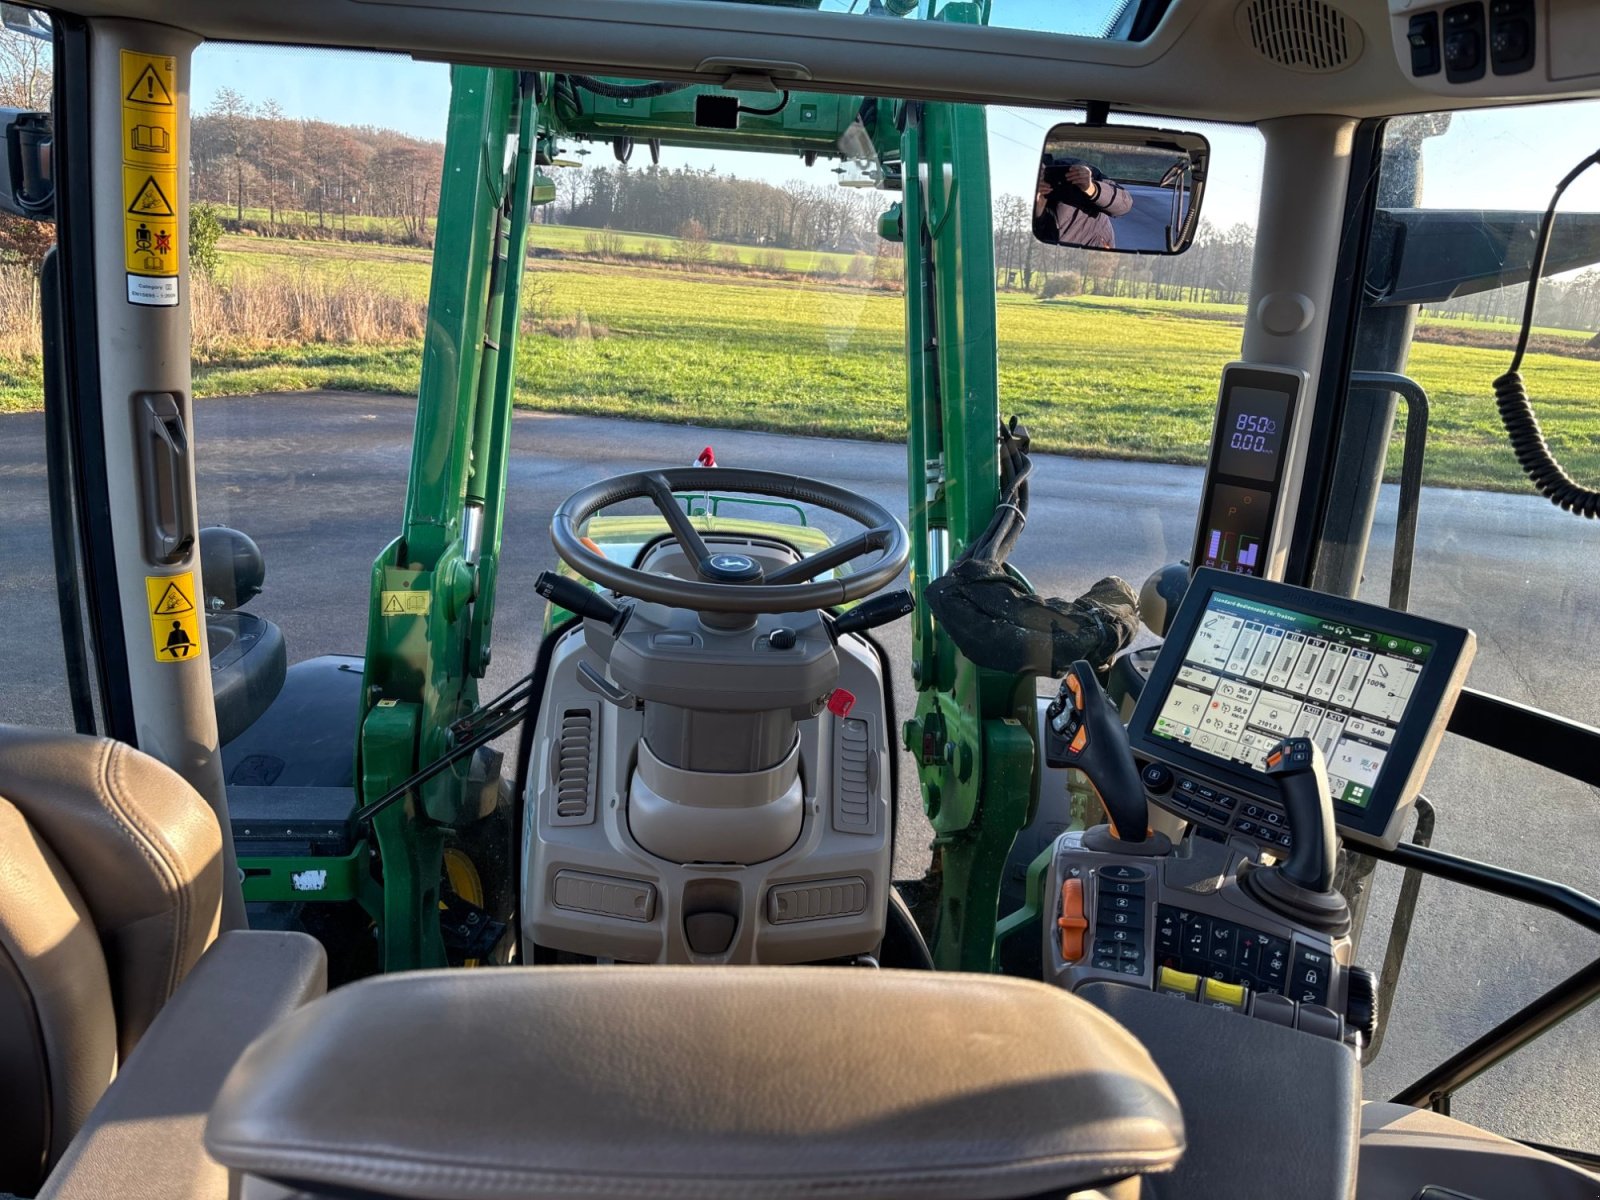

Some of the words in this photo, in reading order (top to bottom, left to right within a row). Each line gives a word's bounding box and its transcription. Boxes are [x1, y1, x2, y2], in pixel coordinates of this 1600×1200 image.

[1236, 413, 1268, 433] 850
[1276, 611, 1297, 622] Traktor
[1200, 631, 1212, 639] 11%
[1366, 678, 1386, 689] 100%
[1328, 712, 1343, 722] XIV
[1370, 727, 1386, 737] 540
[1305, 952, 1321, 963] SET
